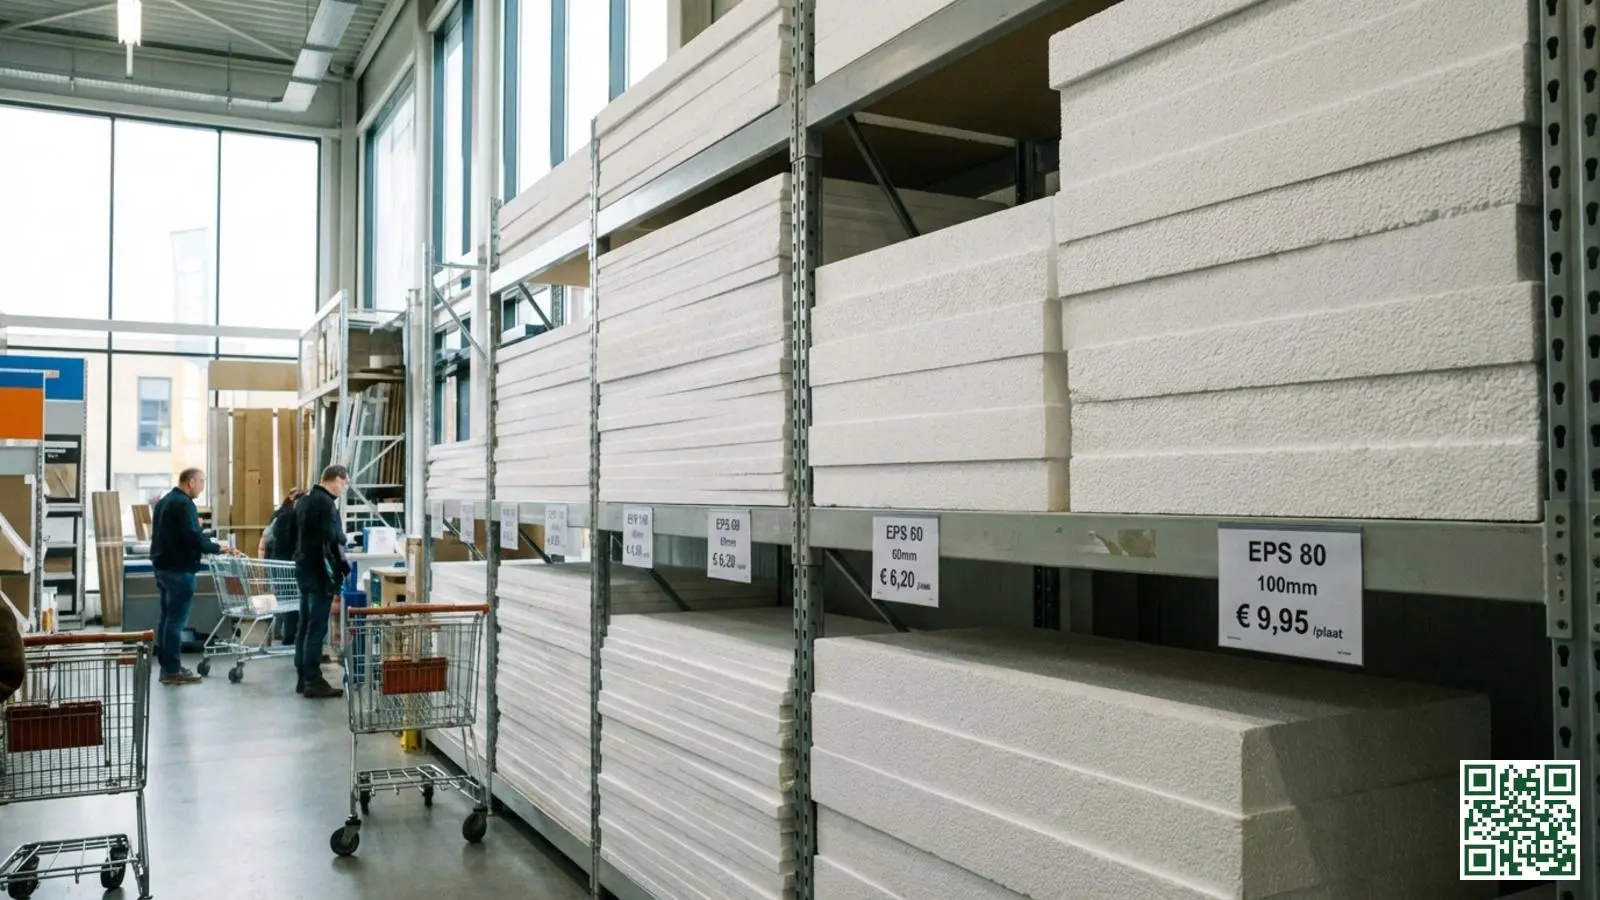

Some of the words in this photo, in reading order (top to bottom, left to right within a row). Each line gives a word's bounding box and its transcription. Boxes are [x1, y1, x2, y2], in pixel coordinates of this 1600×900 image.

[886, 525, 907, 541] EPS
[910, 526, 923, 541] 60
[1248, 541, 1292, 564] EPS
[1300, 543, 1326, 566] 80
[890, 569, 915, 590] 6,20
[1258, 575, 1318, 596] 100mm
[1236, 603, 1250, 628] €
[1257, 605, 1309, 635] 9,95
[1313, 626, 1343, 639] /plaat
